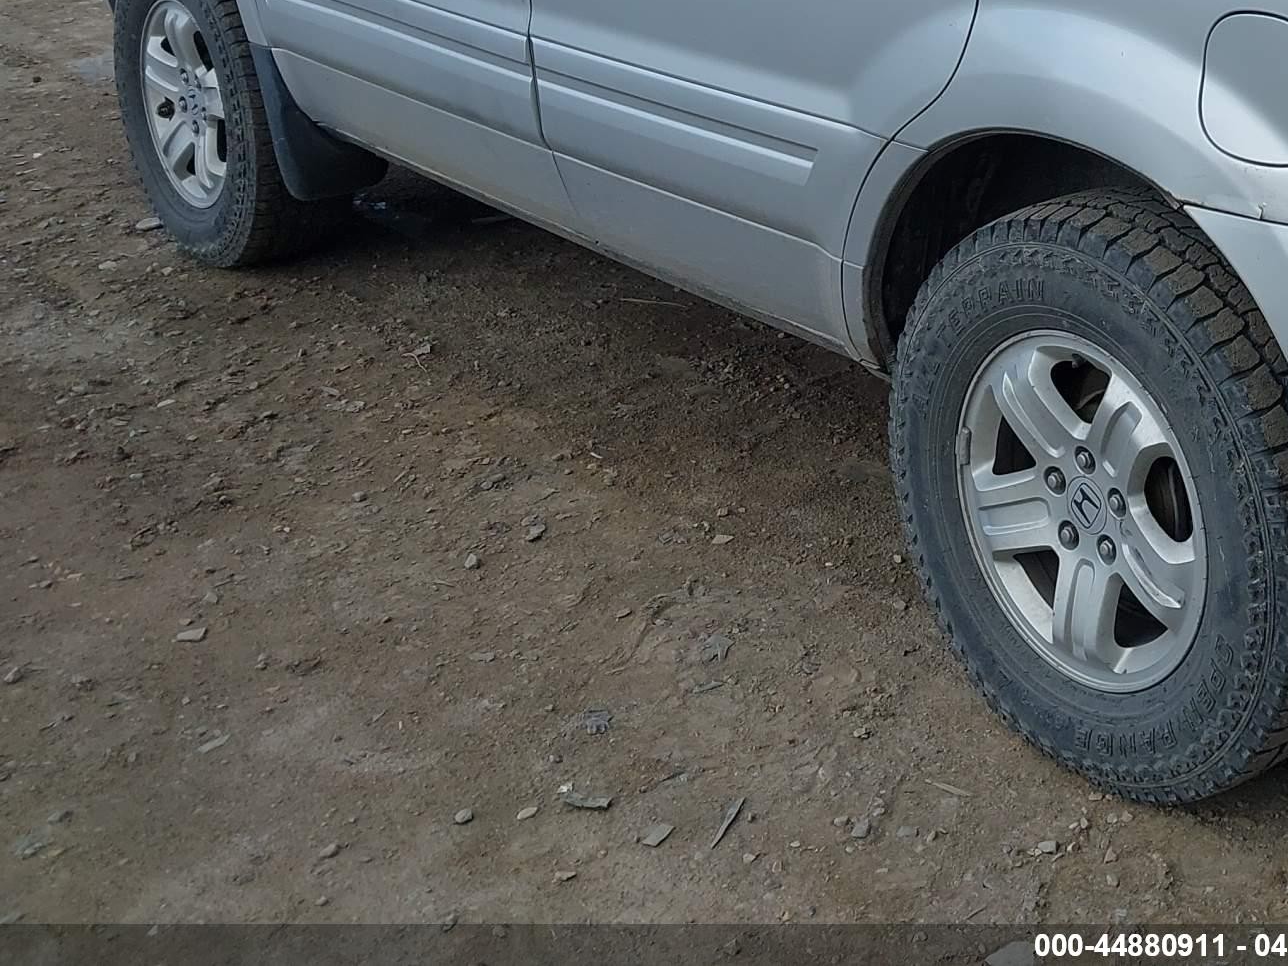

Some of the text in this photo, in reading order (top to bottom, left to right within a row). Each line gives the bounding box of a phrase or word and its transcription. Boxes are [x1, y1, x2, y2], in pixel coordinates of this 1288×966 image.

[936, 276, 1046, 348] TERRAIN
[1075, 634, 1235, 758] OPEN RANGE
